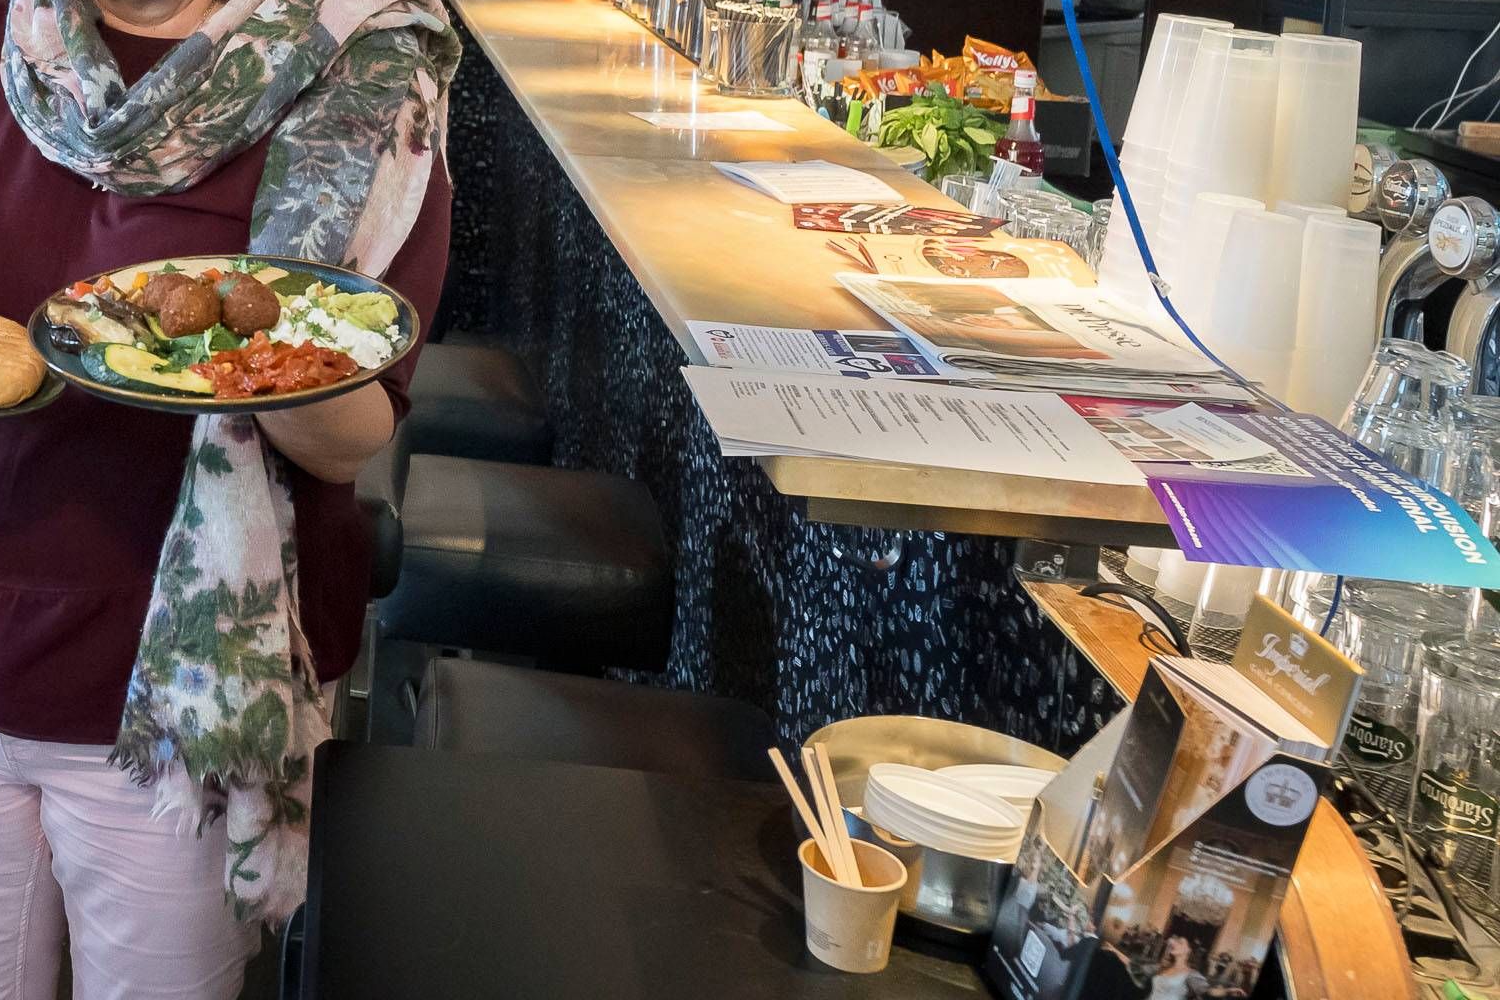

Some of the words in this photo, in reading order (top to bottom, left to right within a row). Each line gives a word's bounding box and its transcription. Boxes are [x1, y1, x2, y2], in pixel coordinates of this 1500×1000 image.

[1302, 436, 1363, 469] CONTEST
[1351, 468, 1404, 496] GRAND
[1391, 495, 1439, 534] FINAL
[1361, 461, 1388, 472] TO
[1400, 485, 1488, 565] EUROVISION
